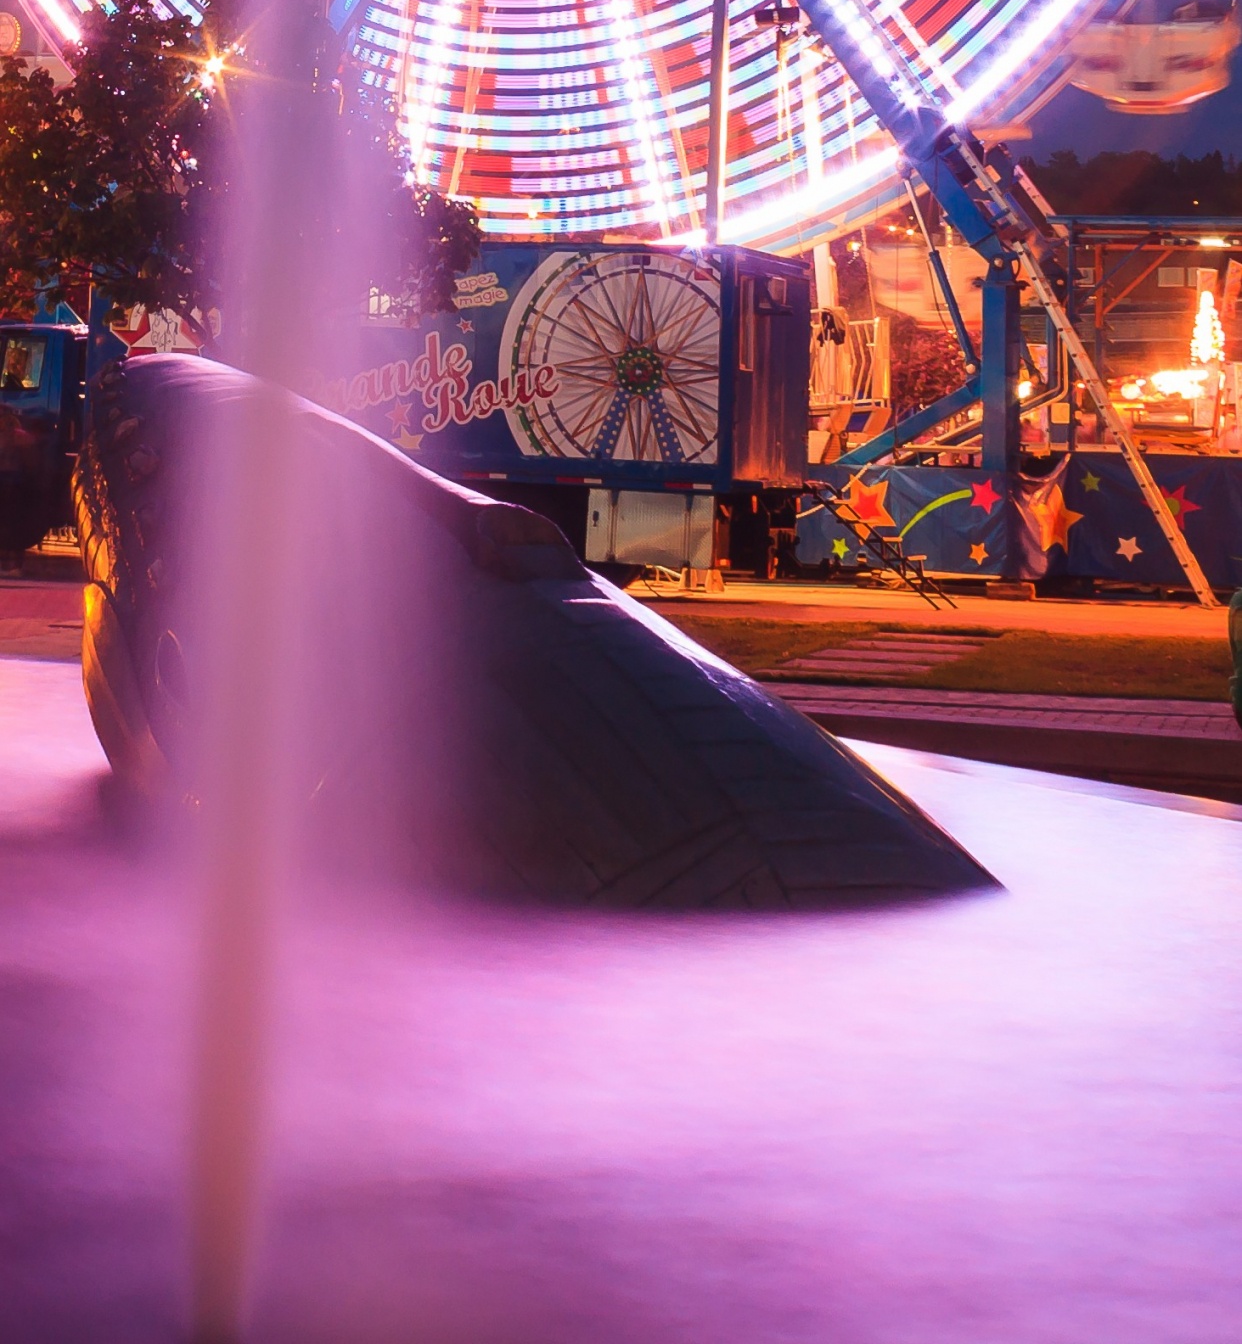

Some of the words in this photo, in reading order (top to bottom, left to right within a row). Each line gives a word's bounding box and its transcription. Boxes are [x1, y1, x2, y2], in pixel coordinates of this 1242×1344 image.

[458, 274, 496, 291] apez
[459, 289, 506, 306] magie
[303, 331, 472, 412] rande
[422, 364, 562, 432] Roue
